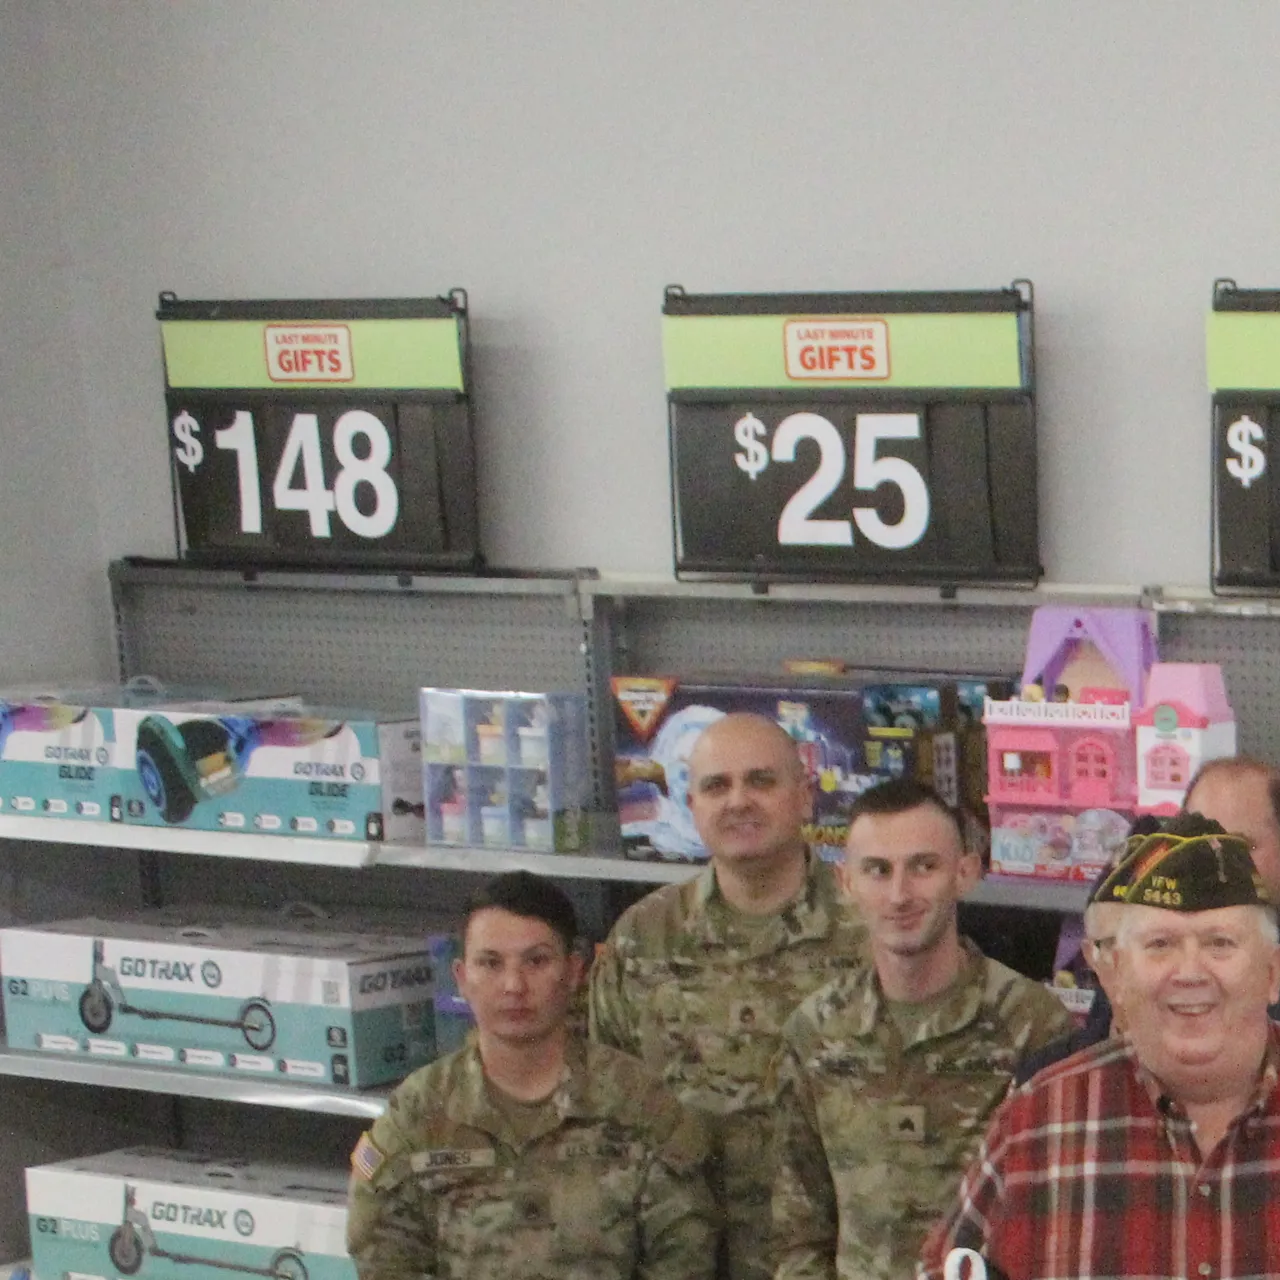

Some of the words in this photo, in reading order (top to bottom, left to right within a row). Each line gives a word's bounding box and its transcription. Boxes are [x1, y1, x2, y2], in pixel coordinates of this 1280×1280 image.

[274, 332, 298, 345] LAST
[301, 332, 340, 346] MINUTE
[797, 328, 826, 341] LAST
[829, 328, 874, 342] MINUTE
[277, 349, 343, 374] GIFTS
[798, 345, 876, 371] GIFTS
[308, 781, 348, 798] GLIDE
[119, 955, 196, 984] GOTRAX
[8, 979, 30, 997] G2
[151, 1200, 228, 1230] GOTRAX
[36, 1216, 58, 1235] G2
